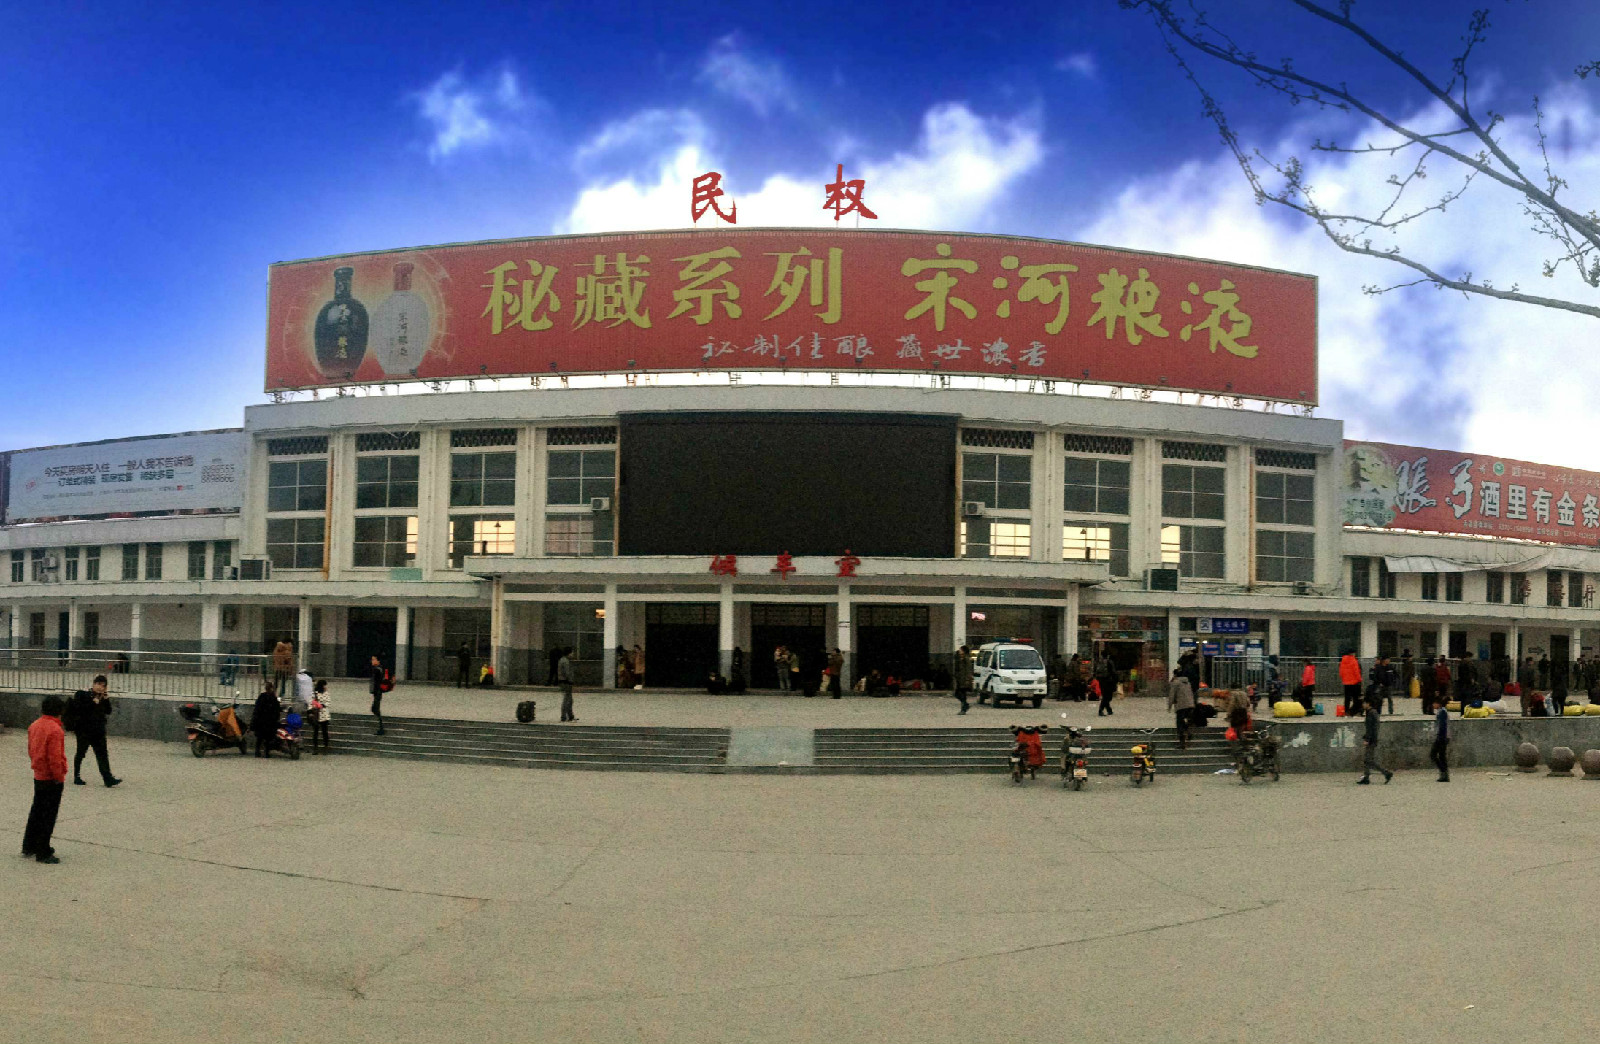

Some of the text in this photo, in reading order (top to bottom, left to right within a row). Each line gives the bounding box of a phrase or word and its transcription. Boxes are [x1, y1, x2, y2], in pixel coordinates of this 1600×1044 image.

[691, 163, 878, 225] 民权
[480, 243, 1259, 358] 秘藏系列 宋河粮液
[1479, 479, 1600, 530] 酒里有金条
